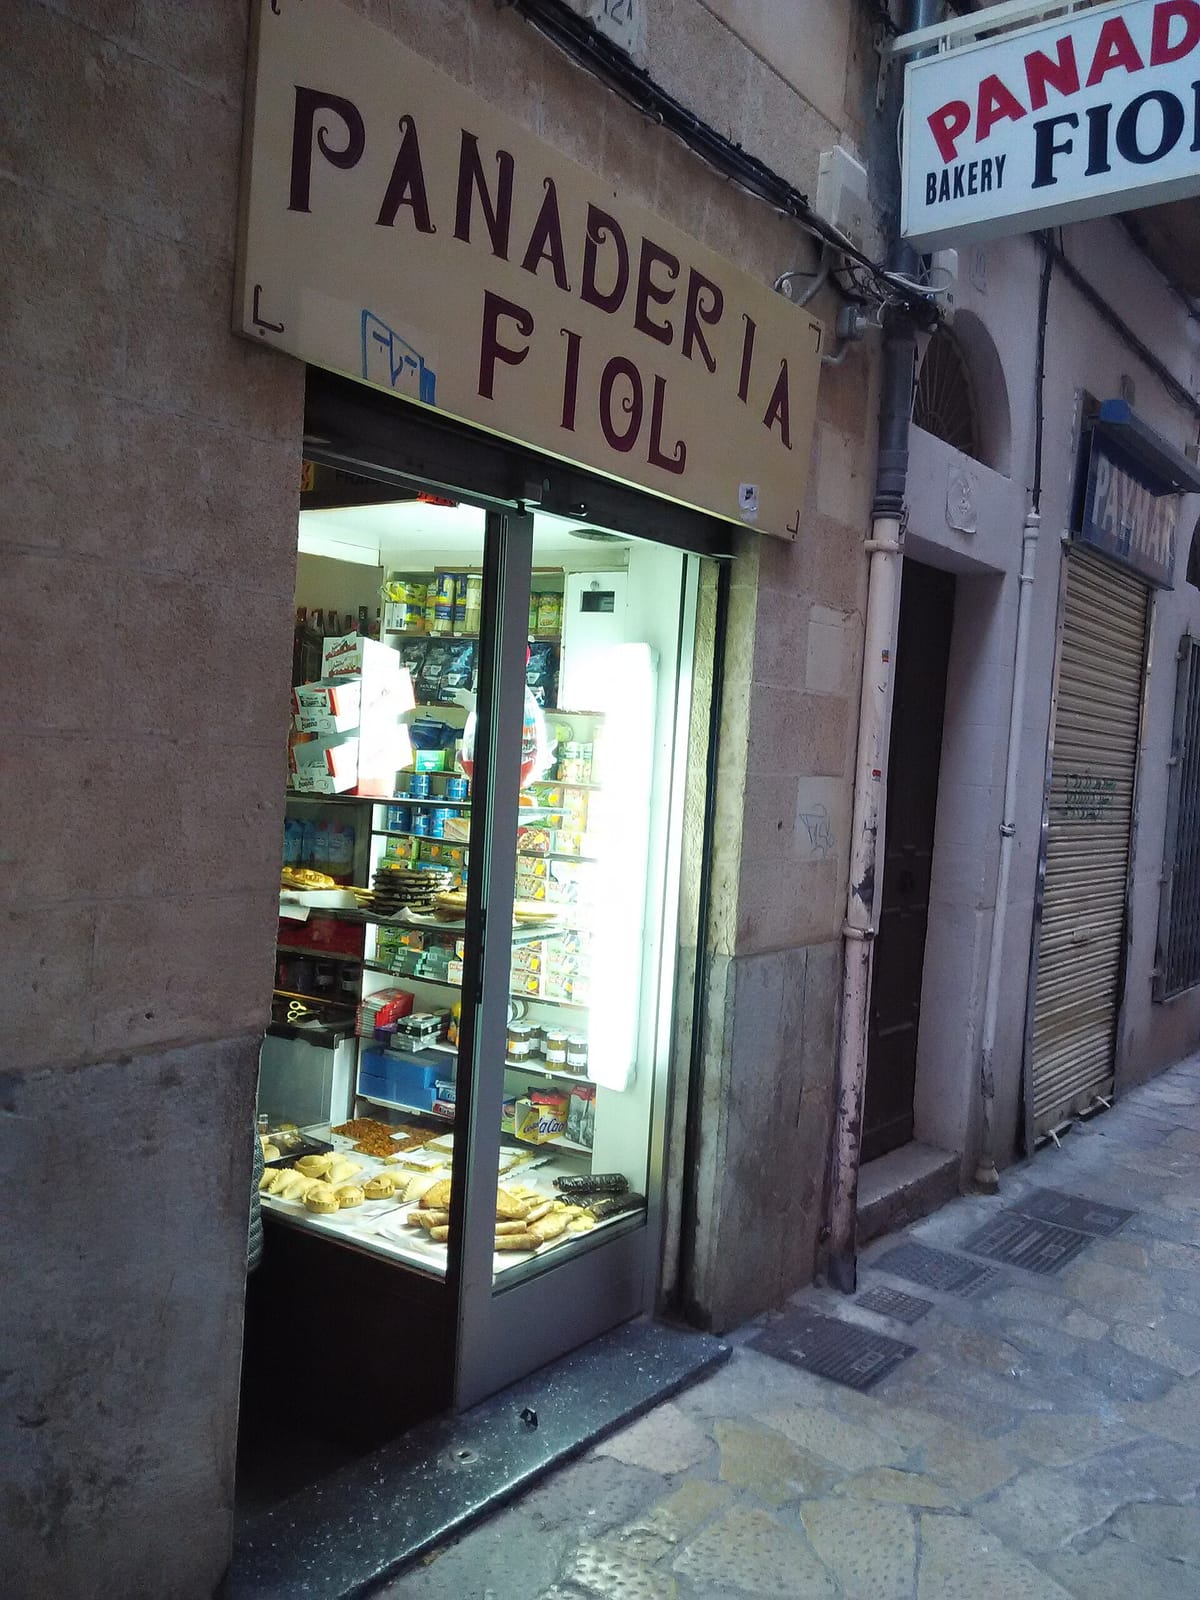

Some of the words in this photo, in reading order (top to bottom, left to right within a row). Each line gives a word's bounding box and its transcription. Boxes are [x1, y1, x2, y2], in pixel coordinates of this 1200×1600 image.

[925, 154, 1007, 206] BAKERY
[1031, 81, 1200, 189] FIO
[287, 84, 793, 451] PANADERIA
[477, 289, 688, 475] FIOL
